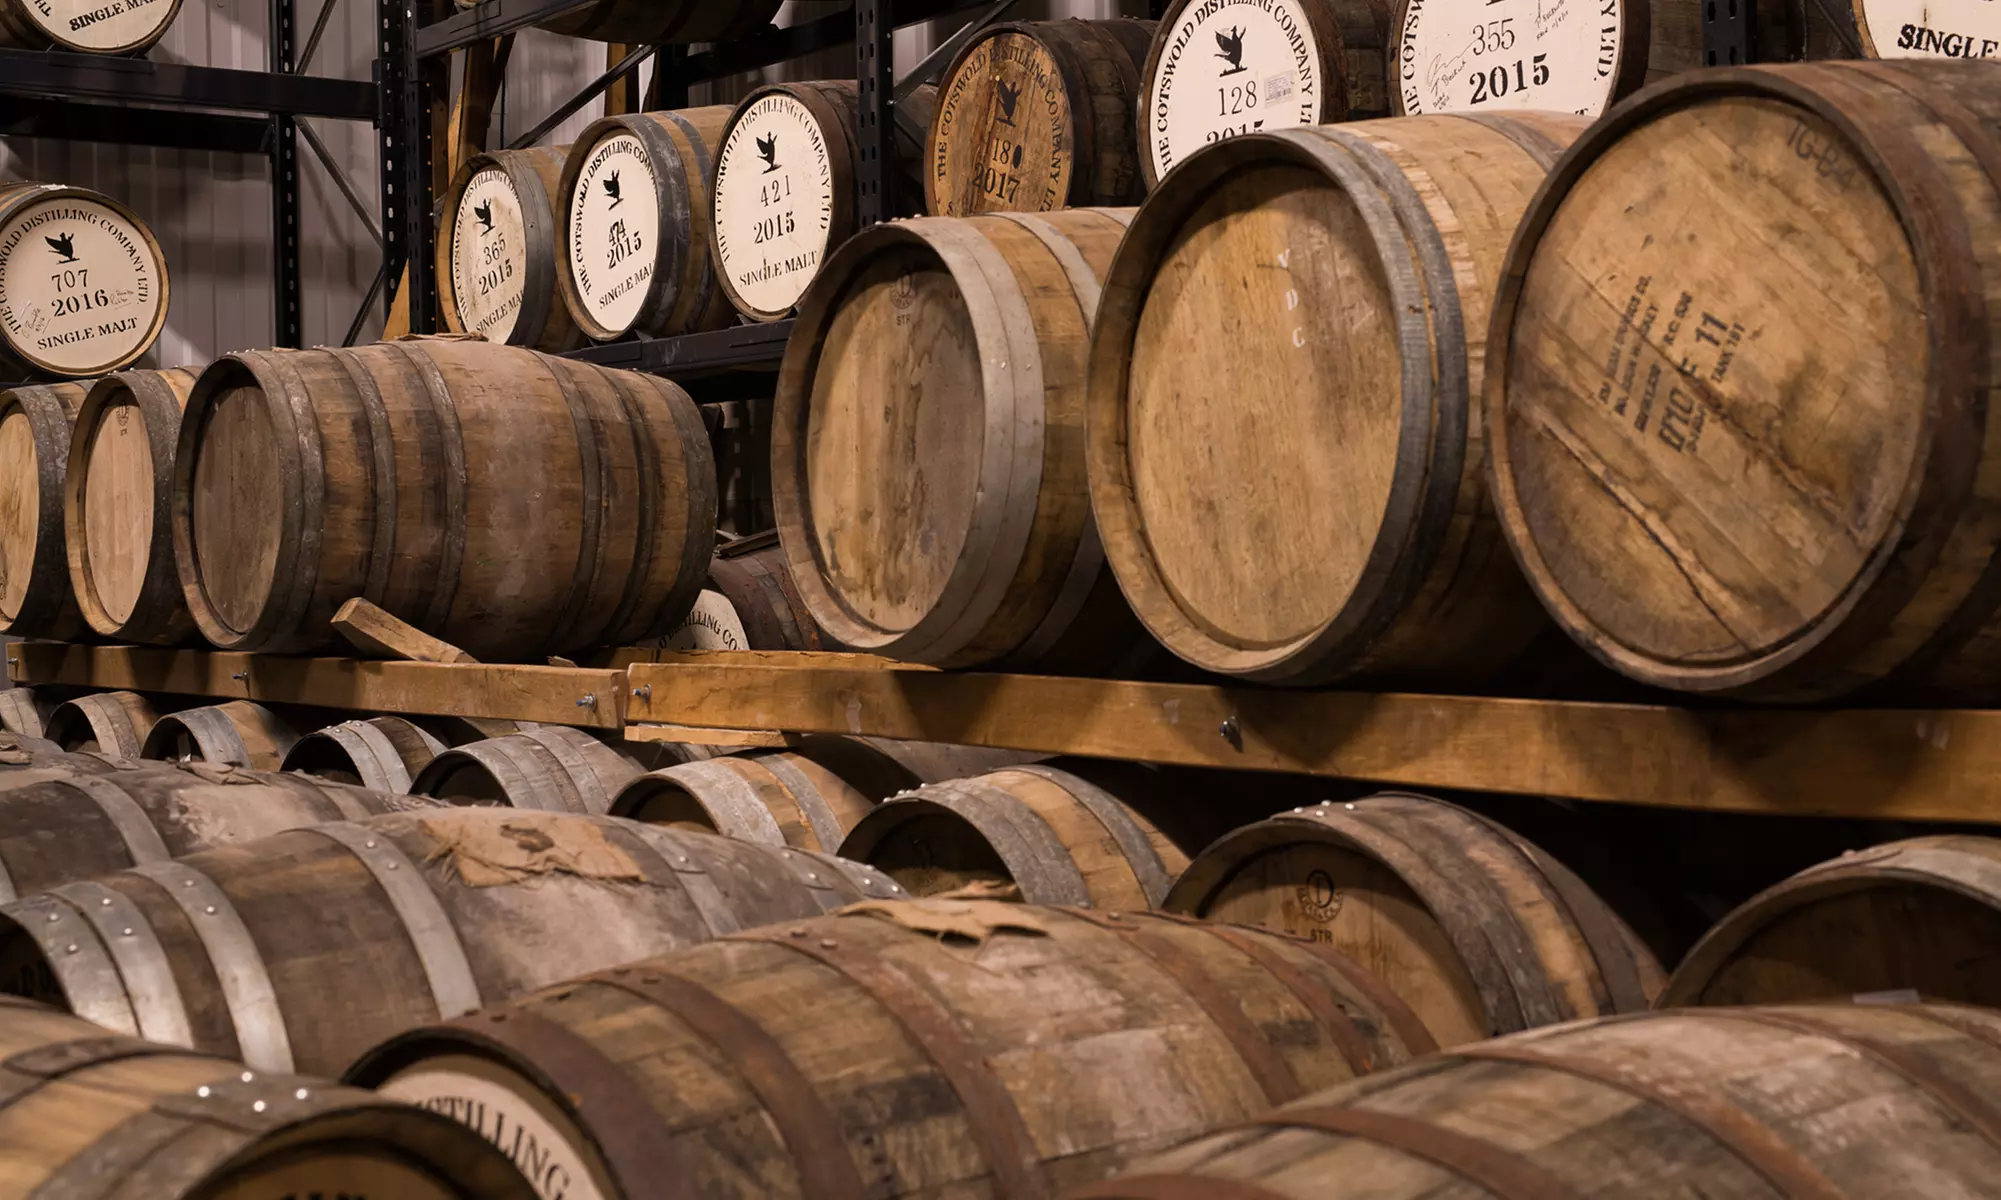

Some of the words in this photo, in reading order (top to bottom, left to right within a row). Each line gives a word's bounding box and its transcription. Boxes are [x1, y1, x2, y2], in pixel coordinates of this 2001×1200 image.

[69, 4, 125, 32] SINGLE
[1472, 18, 1515, 56] 355
[1157, 22, 1195, 133] COTSWOLD
[1274, 5, 1313, 96] COMPANY
[1469, 53, 1550, 105] 2015
[941, 53, 987, 136] COTSWOLD
[1218, 80, 1258, 117] 128
[741, 98, 798, 132] DISTILLING
[799, 112, 830, 188] COMPANY
[1044, 89, 1063, 184] COMPANY
[588, 140, 632, 179] DISTILLING
[937, 141, 948, 182] THE
[761, 175, 791, 208] 421
[972, 162, 1021, 203] 2017
[575, 177, 590, 263] COTSWOLD
[753, 211, 795, 244] 2015
[20, 208, 98, 233] DISTILLING
[99, 219, 146, 273] COMPANY
[483, 232, 506, 265] 365
[606, 231, 642, 270] 2015
[51, 269, 88, 293] 707
[478, 258, 512, 296] 2015
[578, 265, 592, 296] THE
[739, 262, 783, 288] SINGLE
[785, 250, 817, 273] MALT
[51, 289, 109, 318] 2016
[599, 276, 633, 309] SINGLE
[37, 327, 95, 350] SINGLE
[98, 317, 138, 336] MALT
[475, 304, 508, 333] SINGLE
